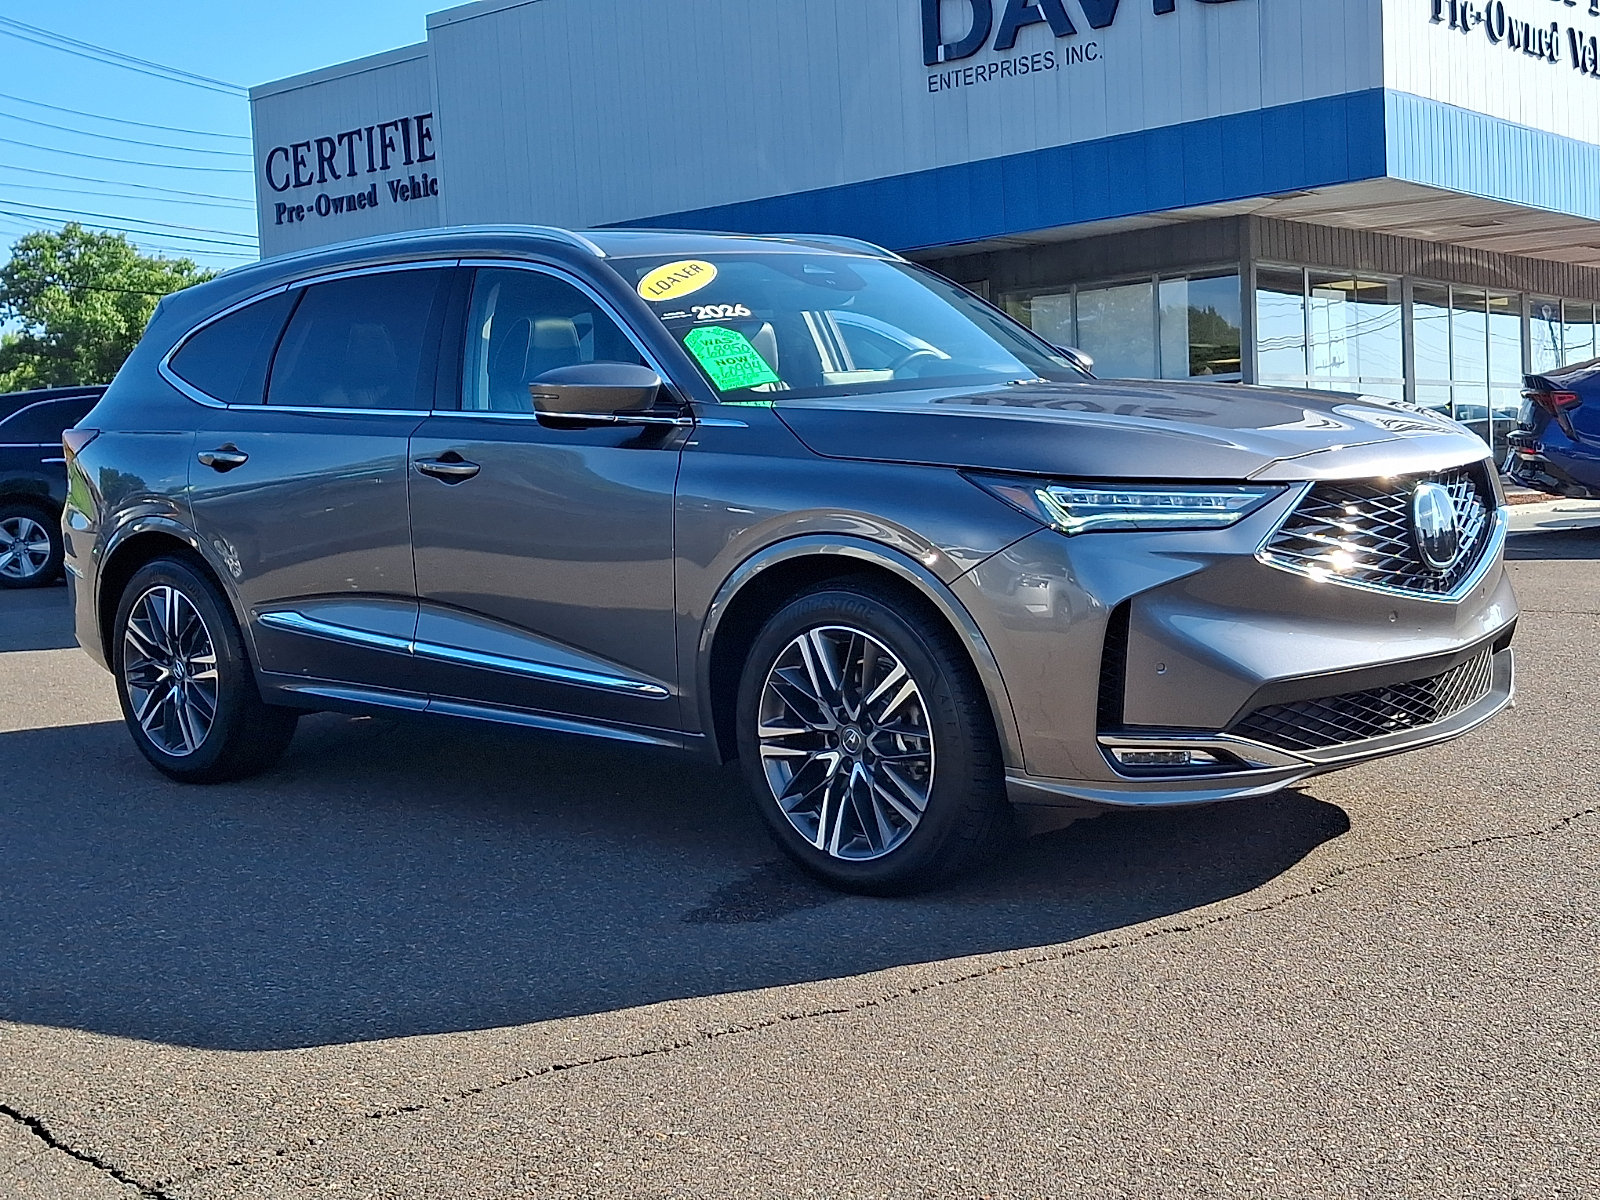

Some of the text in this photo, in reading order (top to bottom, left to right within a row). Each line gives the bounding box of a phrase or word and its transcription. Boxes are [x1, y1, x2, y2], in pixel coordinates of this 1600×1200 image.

[928, 42, 1103, 93] ENTERPRISES, INC.
[265, 112, 436, 192] CERTIFIE
[274, 173, 439, 225] Pre-Owned Vehic
[691, 303, 752, 320] 2026
[700, 338, 734, 347] WAS
